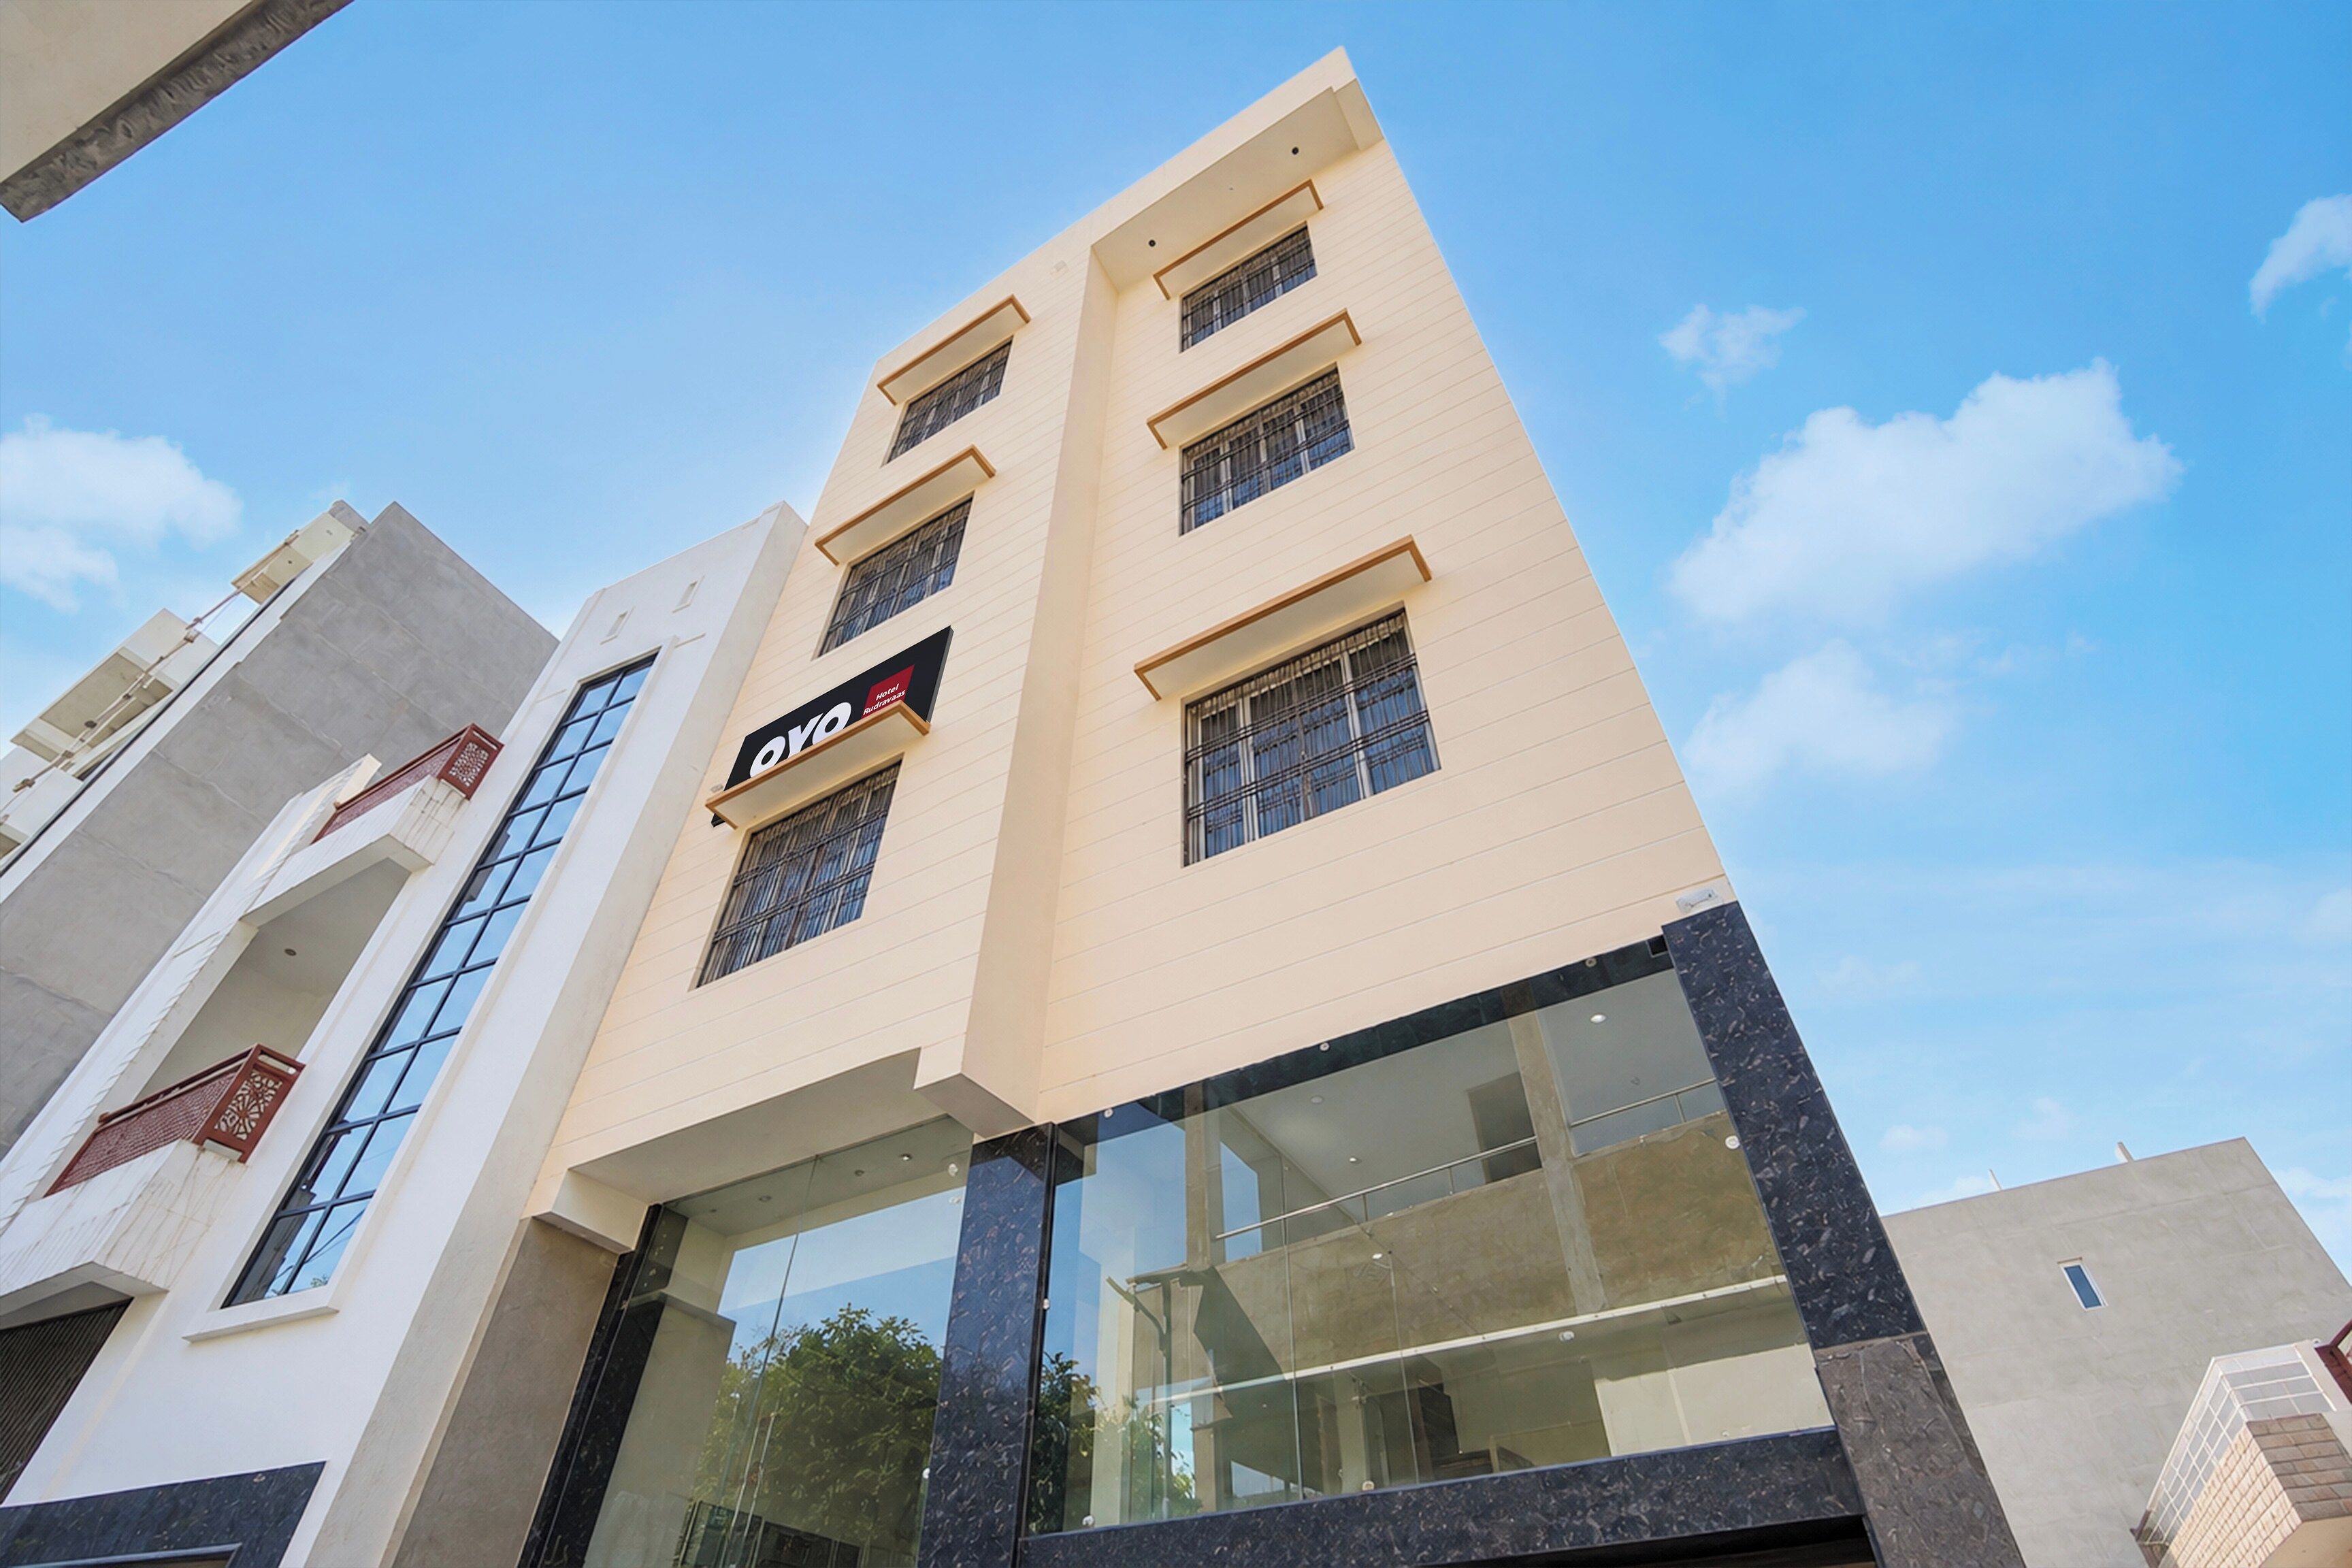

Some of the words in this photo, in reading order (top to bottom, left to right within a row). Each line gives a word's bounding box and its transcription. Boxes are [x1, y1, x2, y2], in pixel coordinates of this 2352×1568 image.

[862, 689, 906, 716] Rudravaas
[875, 683, 900, 701] Hotel
[749, 702, 852, 778] OYO
